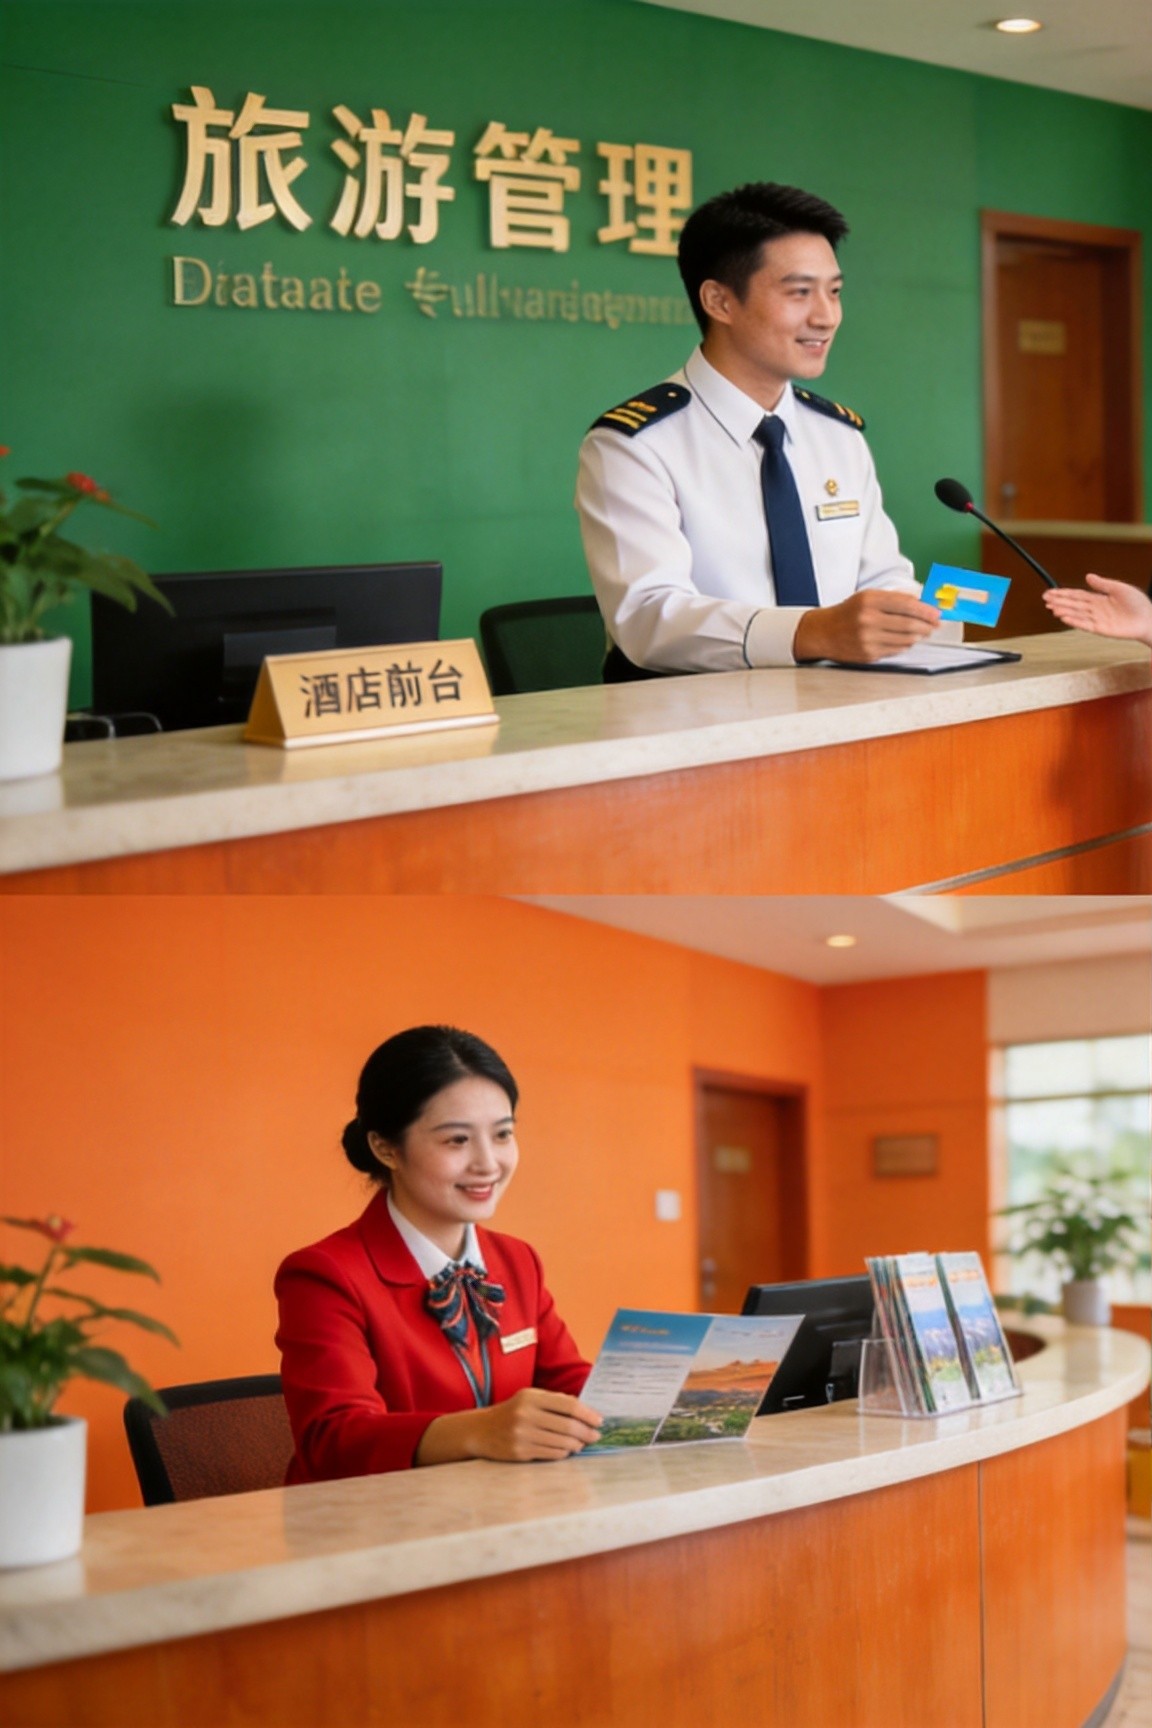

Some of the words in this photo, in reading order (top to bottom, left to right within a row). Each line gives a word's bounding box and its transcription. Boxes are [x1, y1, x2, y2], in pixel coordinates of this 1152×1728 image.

[171, 86, 693, 257] 旅游管理
[299, 659, 464, 718] 酒店前台
